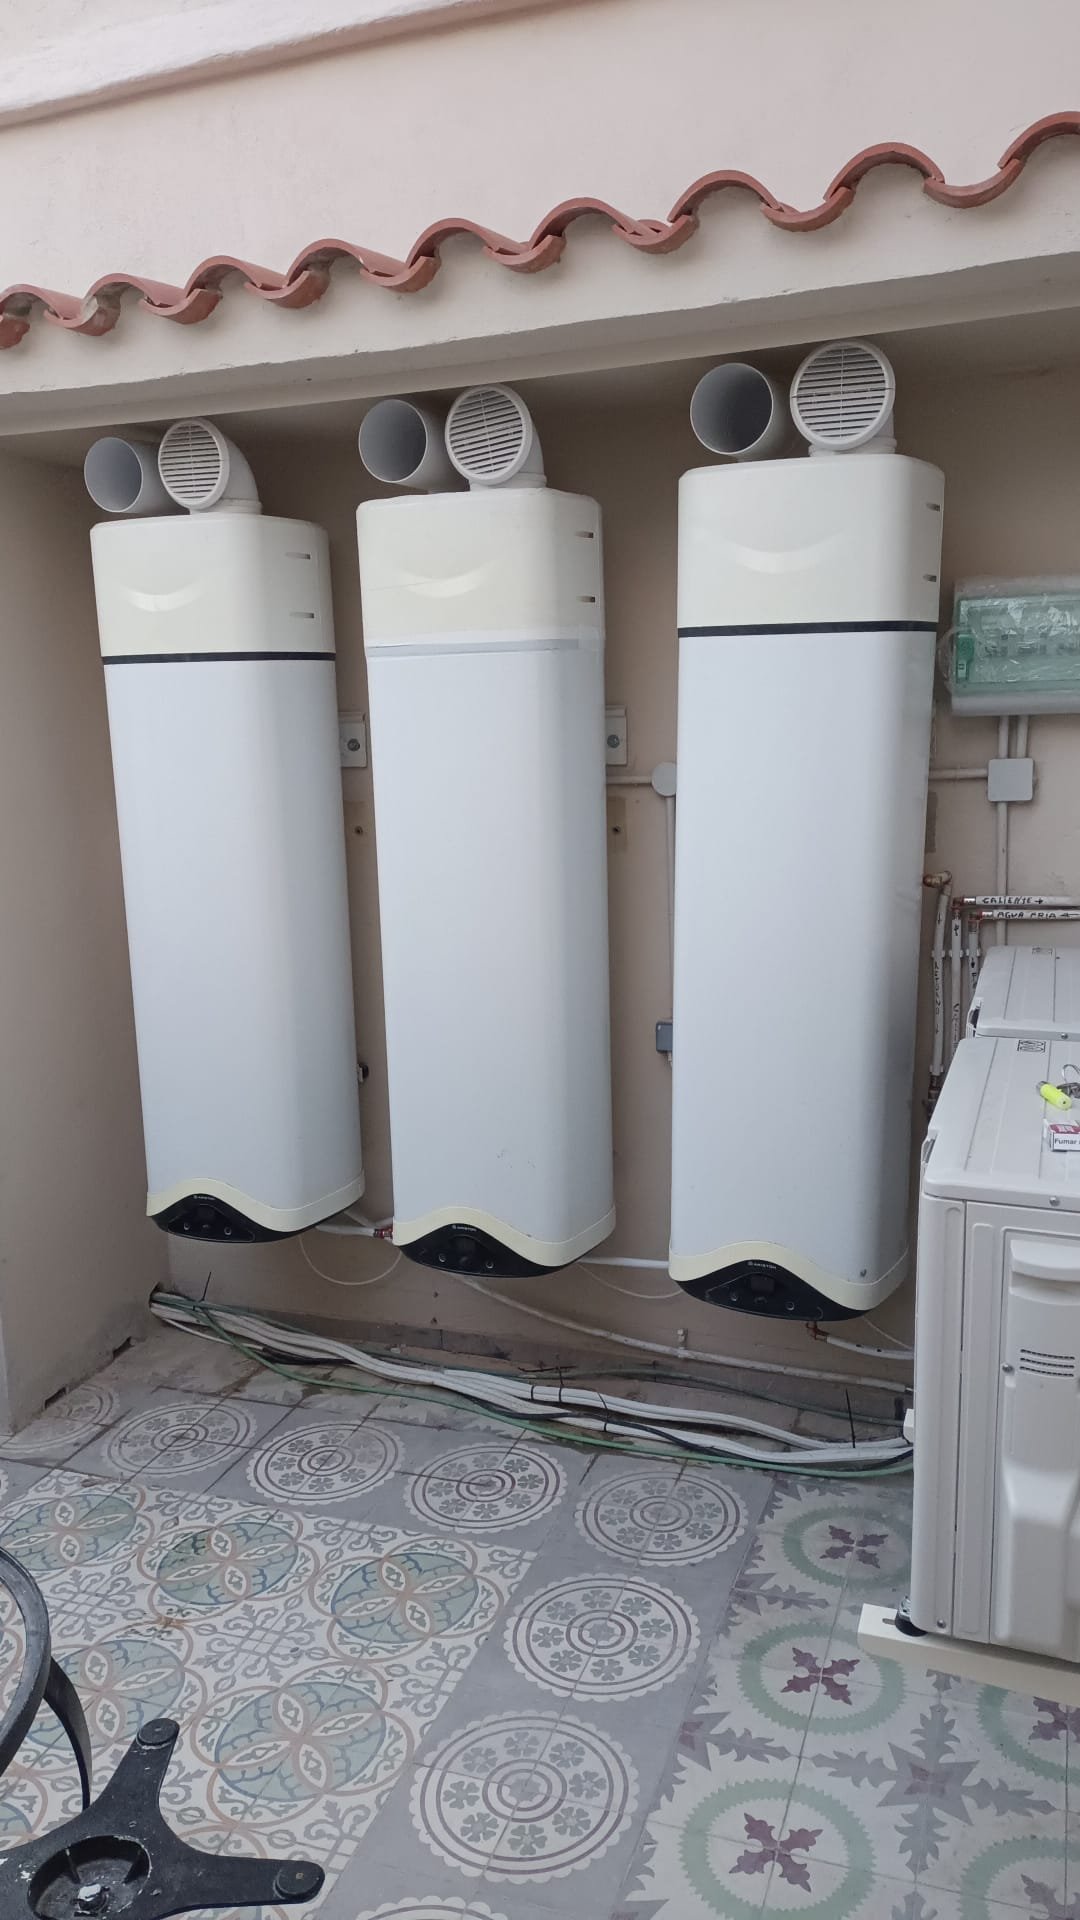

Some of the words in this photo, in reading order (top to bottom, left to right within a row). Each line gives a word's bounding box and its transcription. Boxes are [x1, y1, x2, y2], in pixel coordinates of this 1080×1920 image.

[982, 896, 1033, 905] CALIENTE
[997, 911, 1025, 919] AGUA
[1054, 1137, 1077, 1145] Fumar
